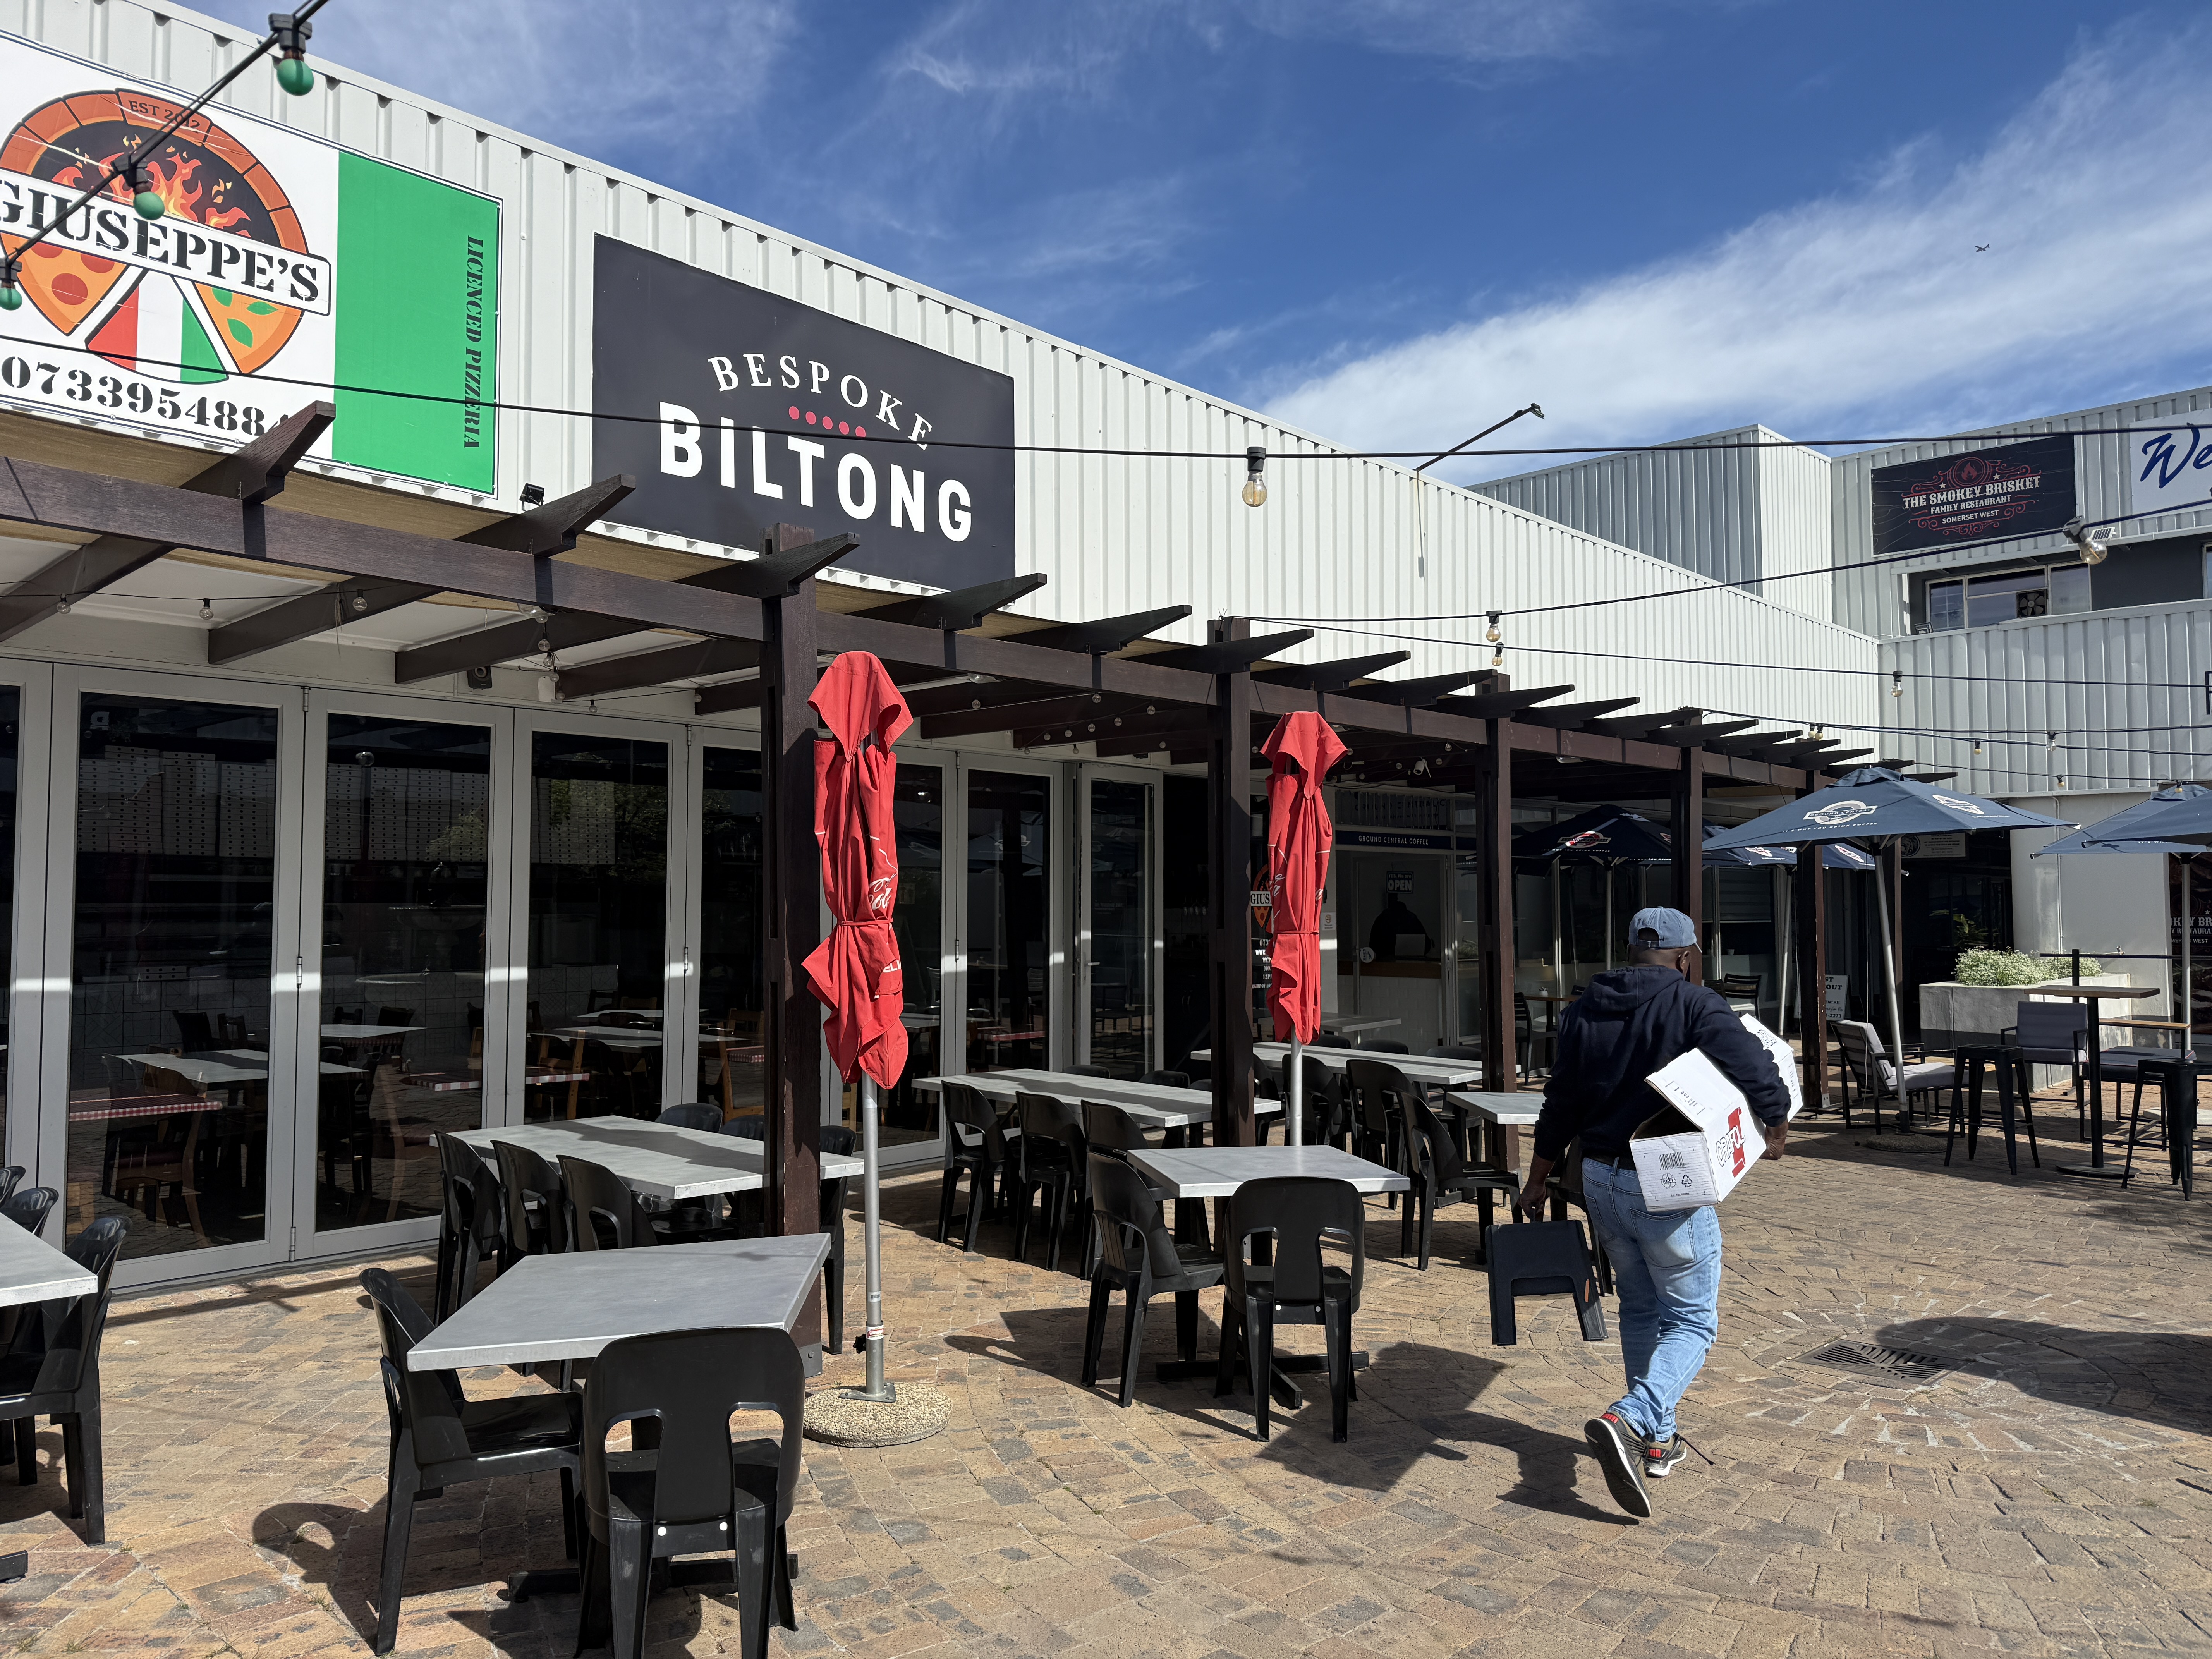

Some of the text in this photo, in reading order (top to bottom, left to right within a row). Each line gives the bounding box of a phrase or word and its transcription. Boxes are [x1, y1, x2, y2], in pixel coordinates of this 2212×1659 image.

[128, 100, 160, 117] EST
[0, 179, 319, 302] GIUSEPPE'S
[464, 235, 483, 448] LICENCED PIZZERIA
[1, 356, 289, 436] 073395488
[708, 353, 933, 450] BESPOKE
[659, 401, 972, 542] BILTONG
[1903, 476, 2041, 509] THE SMOKEY BRISKET
[1930, 495, 2011, 515] FAMILY RESTAURANT
[1942, 510, 1999, 524] SOMERSET WEST
[1250, 893, 1270, 904] GIUS
[1388, 879, 1412, 891] OPEN
[1716, 1126, 1745, 1167] ORAFOL
